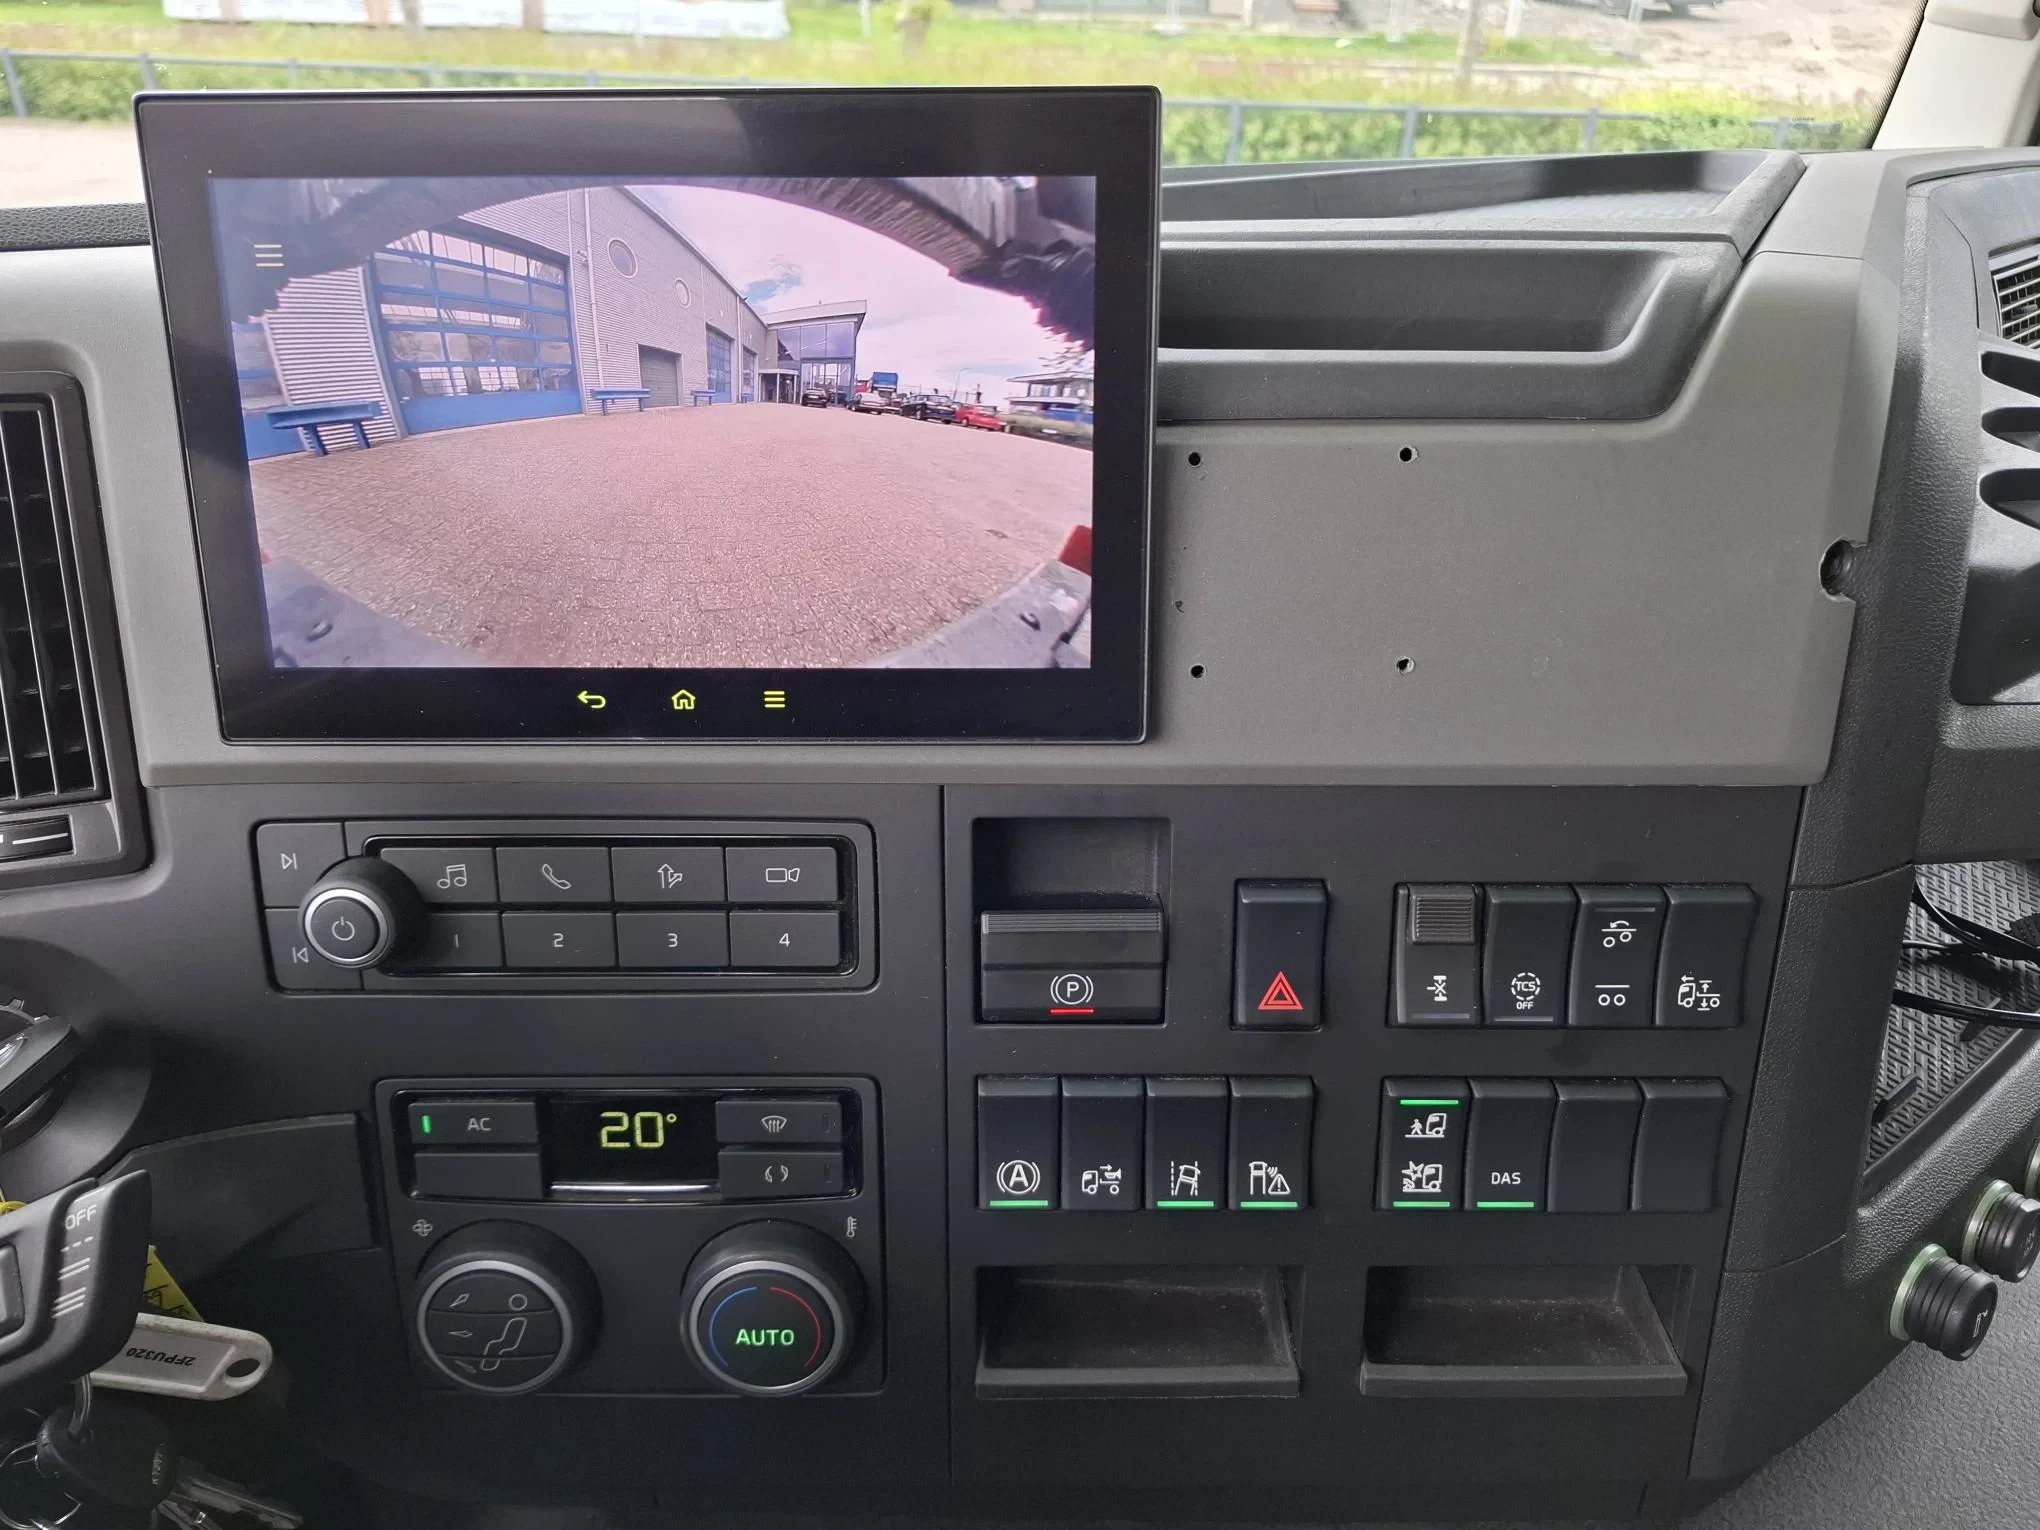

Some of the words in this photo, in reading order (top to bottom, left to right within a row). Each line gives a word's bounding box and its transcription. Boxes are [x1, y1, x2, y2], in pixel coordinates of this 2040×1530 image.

[552, 933, 565, 948] 2
[667, 933, 679, 948] 3
[778, 933, 791, 948] 4
[1066, 981, 1080, 997] P
[1514, 980, 1537, 993] TCS
[1515, 1001, 1534, 1011] OFF
[466, 1116, 491, 1132] AC
[1008, 1165, 1030, 1188] A
[1490, 1171, 1522, 1186] DAS
[64, 1203, 98, 1231] OFF
[734, 1328, 796, 1347] AUTO
[125, 1347, 197, 1367] 2FPU320
